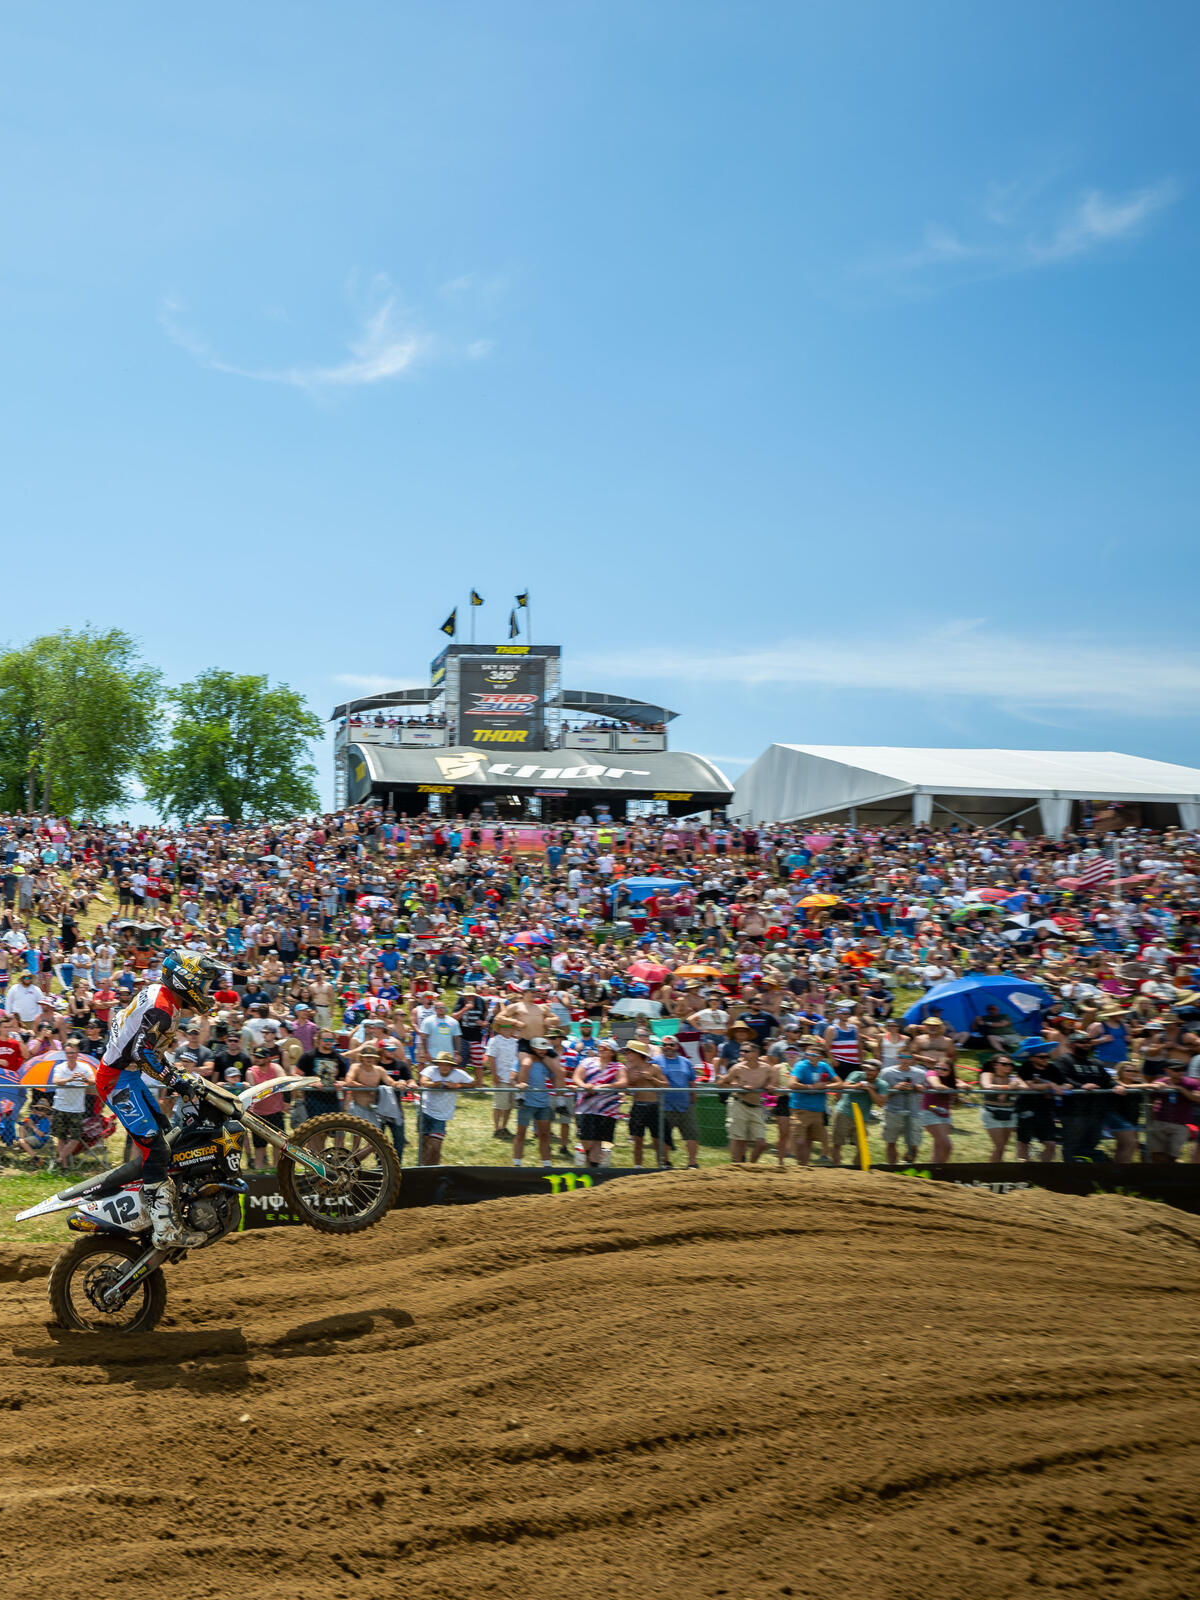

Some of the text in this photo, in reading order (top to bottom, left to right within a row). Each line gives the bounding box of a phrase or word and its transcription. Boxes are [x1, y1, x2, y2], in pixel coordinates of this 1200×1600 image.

[495, 646, 530, 654] THOR
[472, 729, 529, 742] THOR
[417, 784, 455, 793] THOR
[652, 792, 693, 801] THOR
[172, 1145, 218, 1163] ROCKSTAR
[179, 1154, 216, 1167] ENERGY DRINK
[102, 1195, 140, 1225] 12
